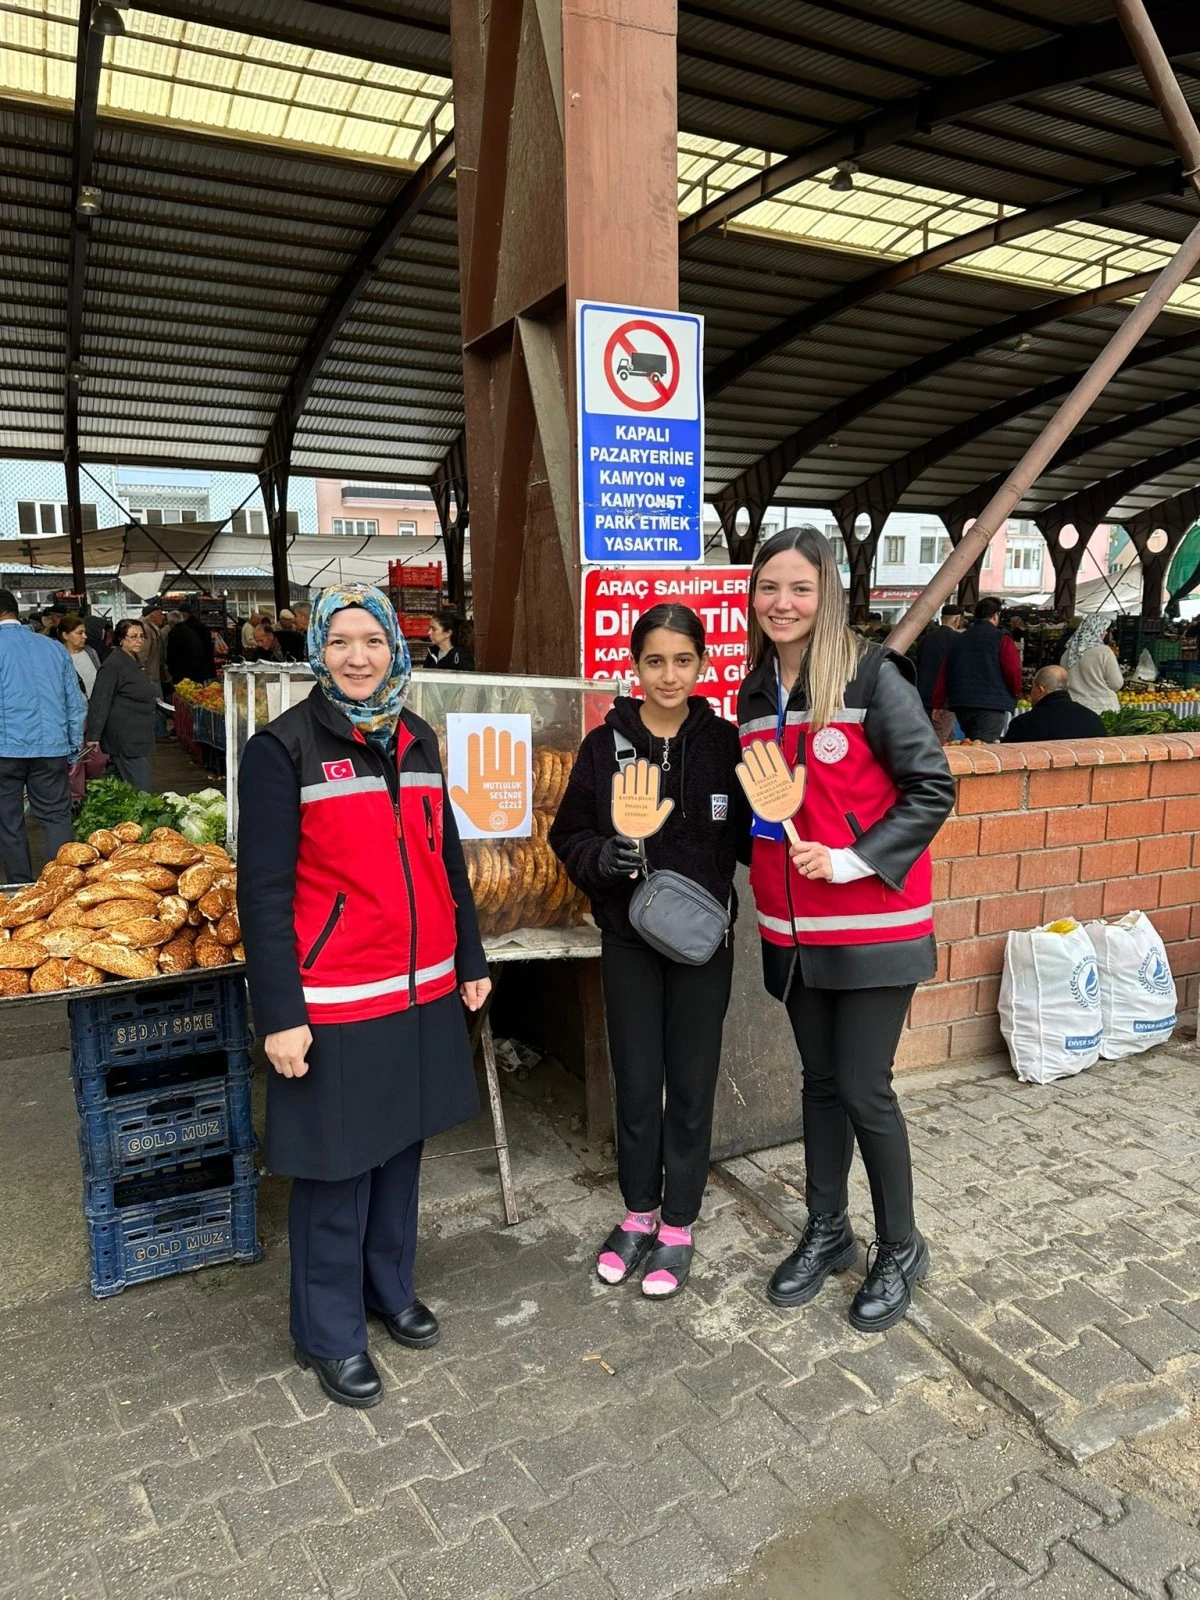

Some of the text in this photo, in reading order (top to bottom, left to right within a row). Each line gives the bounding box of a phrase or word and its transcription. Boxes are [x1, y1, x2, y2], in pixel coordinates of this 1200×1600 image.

[615, 424, 670, 443] KAPALI
[589, 446, 694, 466] PAZARYERİNE
[599, 469, 686, 488] KAMYON ve
[601, 492, 684, 509] KAMYONET
[595, 514, 690, 530] PARK ETMEK
[604, 536, 683, 552] YASAKTIR.
[595, 579, 649, 599] ARAÇ
[594, 647, 631, 662] KAP
[482, 781, 522, 790] MUTLULUK
[489, 790, 522, 799] SESİNDE
[498, 799, 522, 809] GİZLİ
[117, 1013, 214, 1044] SEDAT SÖKE
[1067, 1039, 1087, 1047] ENVER
[128, 1120, 220, 1153] GOLD MUZ
[134, 1231, 224, 1262] GOLD MUZ
